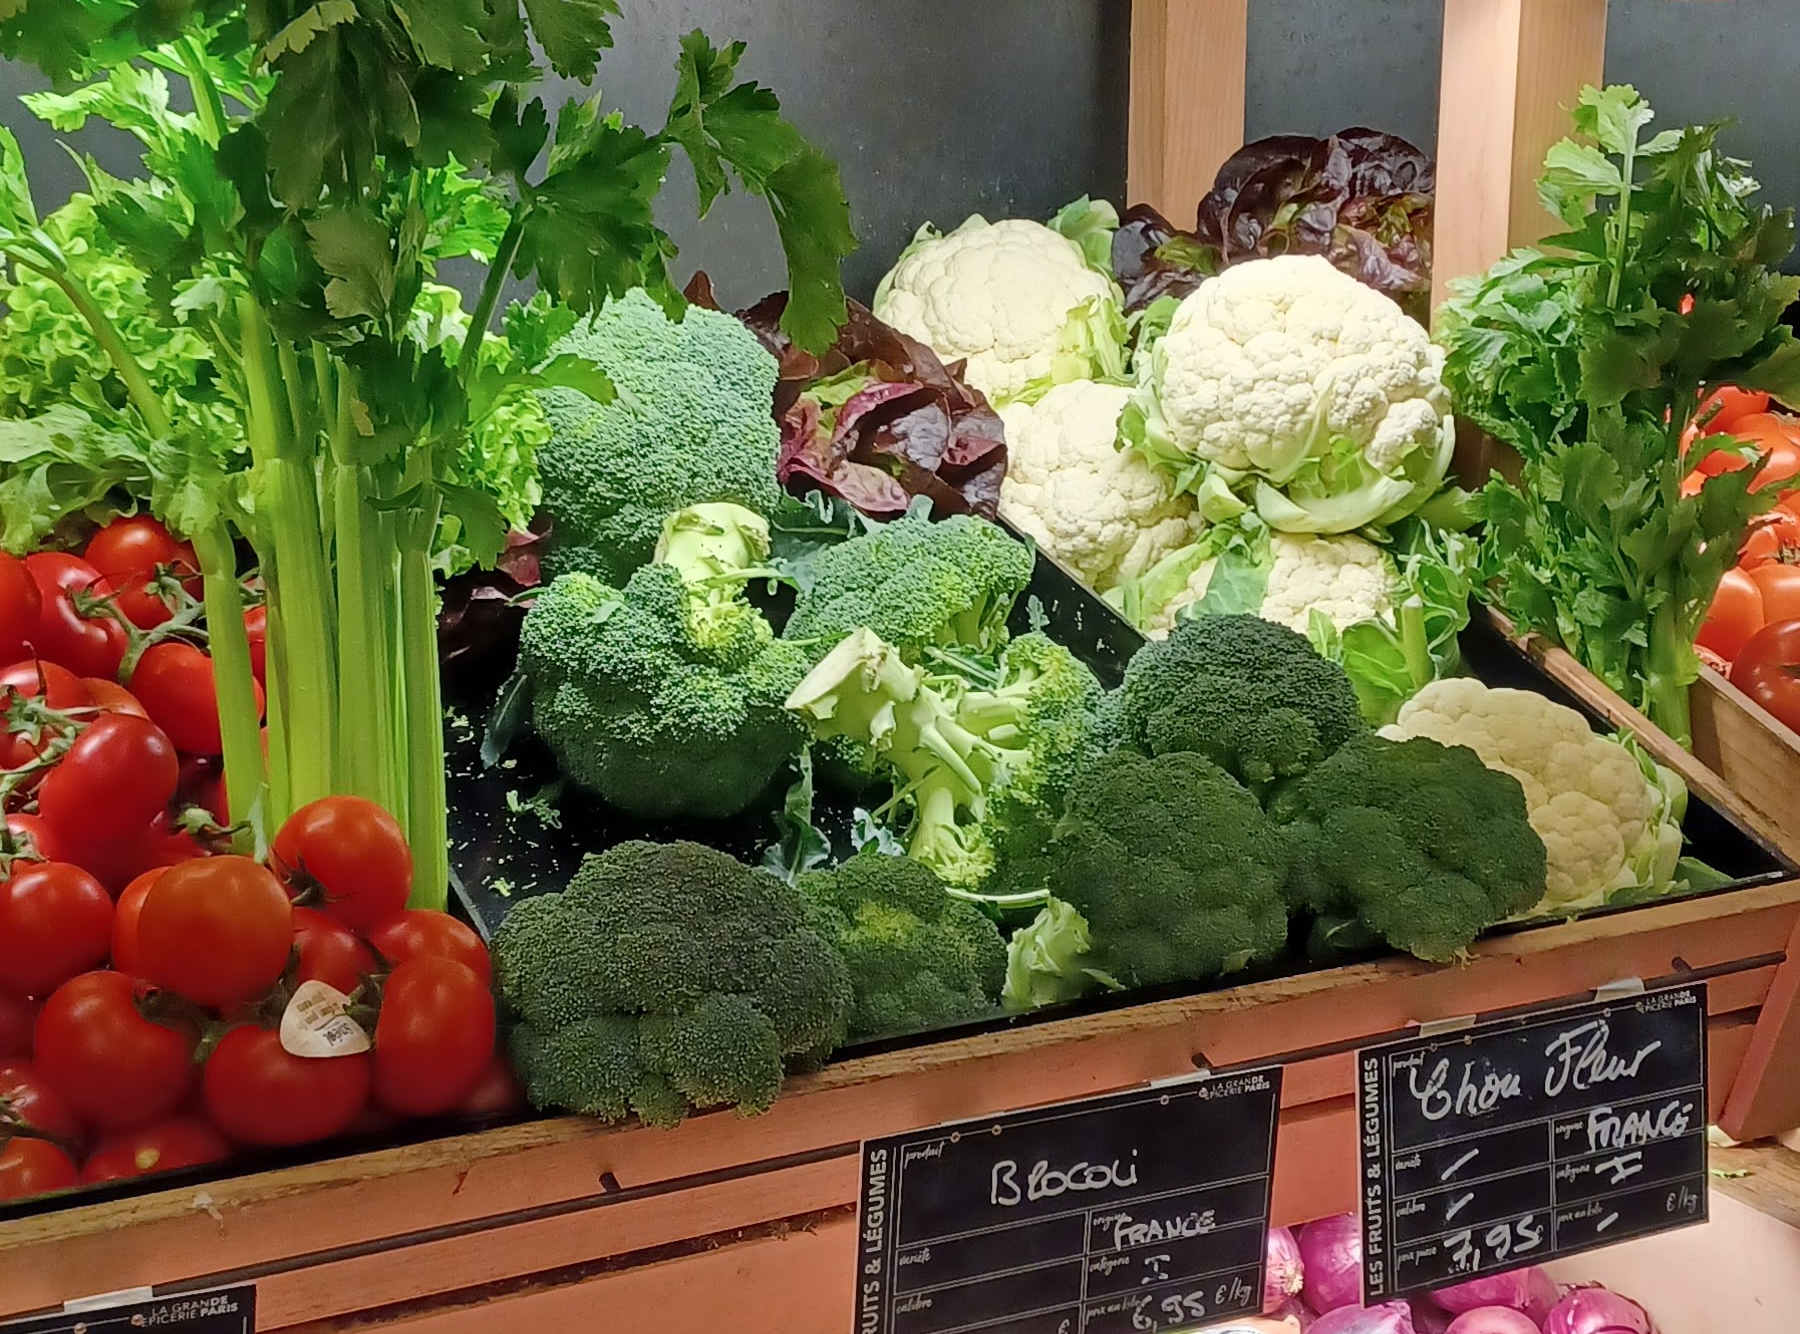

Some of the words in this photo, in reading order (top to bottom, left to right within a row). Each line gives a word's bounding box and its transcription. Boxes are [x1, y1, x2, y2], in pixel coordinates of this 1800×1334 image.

[1226, 1075, 1264, 1088] GRANDE
[1409, 1057, 1521, 1120] Chou
[1544, 1019, 1661, 1098] Fleur
[1244, 1081, 1270, 1093] PARIS
[1363, 1057, 1381, 1158] LÉGUMES
[1586, 1100, 1694, 1154] FRANCE
[904, 1141, 945, 1169] produit
[1366, 1162, 1382, 1179] &
[863, 1148, 887, 1253] LÉGUMES
[1666, 1185, 1698, 1215] €/kg
[1114, 1209, 1216, 1252] FRANCE
[1366, 1183, 1383, 1257] FRUITS
[1444, 1214, 1541, 1271] 7,95
[864, 1257, 881, 1275] &
[1369, 1259, 1384, 1296] LES
[141, 1309, 197, 1328] EPICERIE
[200, 1302, 239, 1318] PARIS
[152, 1305, 168, 1317] LA
[172, 1294, 229, 1313] GRANDE
[896, 1292, 932, 1315] calibre
[1132, 1290, 1206, 1334] 6,95
[1215, 1276, 1253, 1307] €/kg
